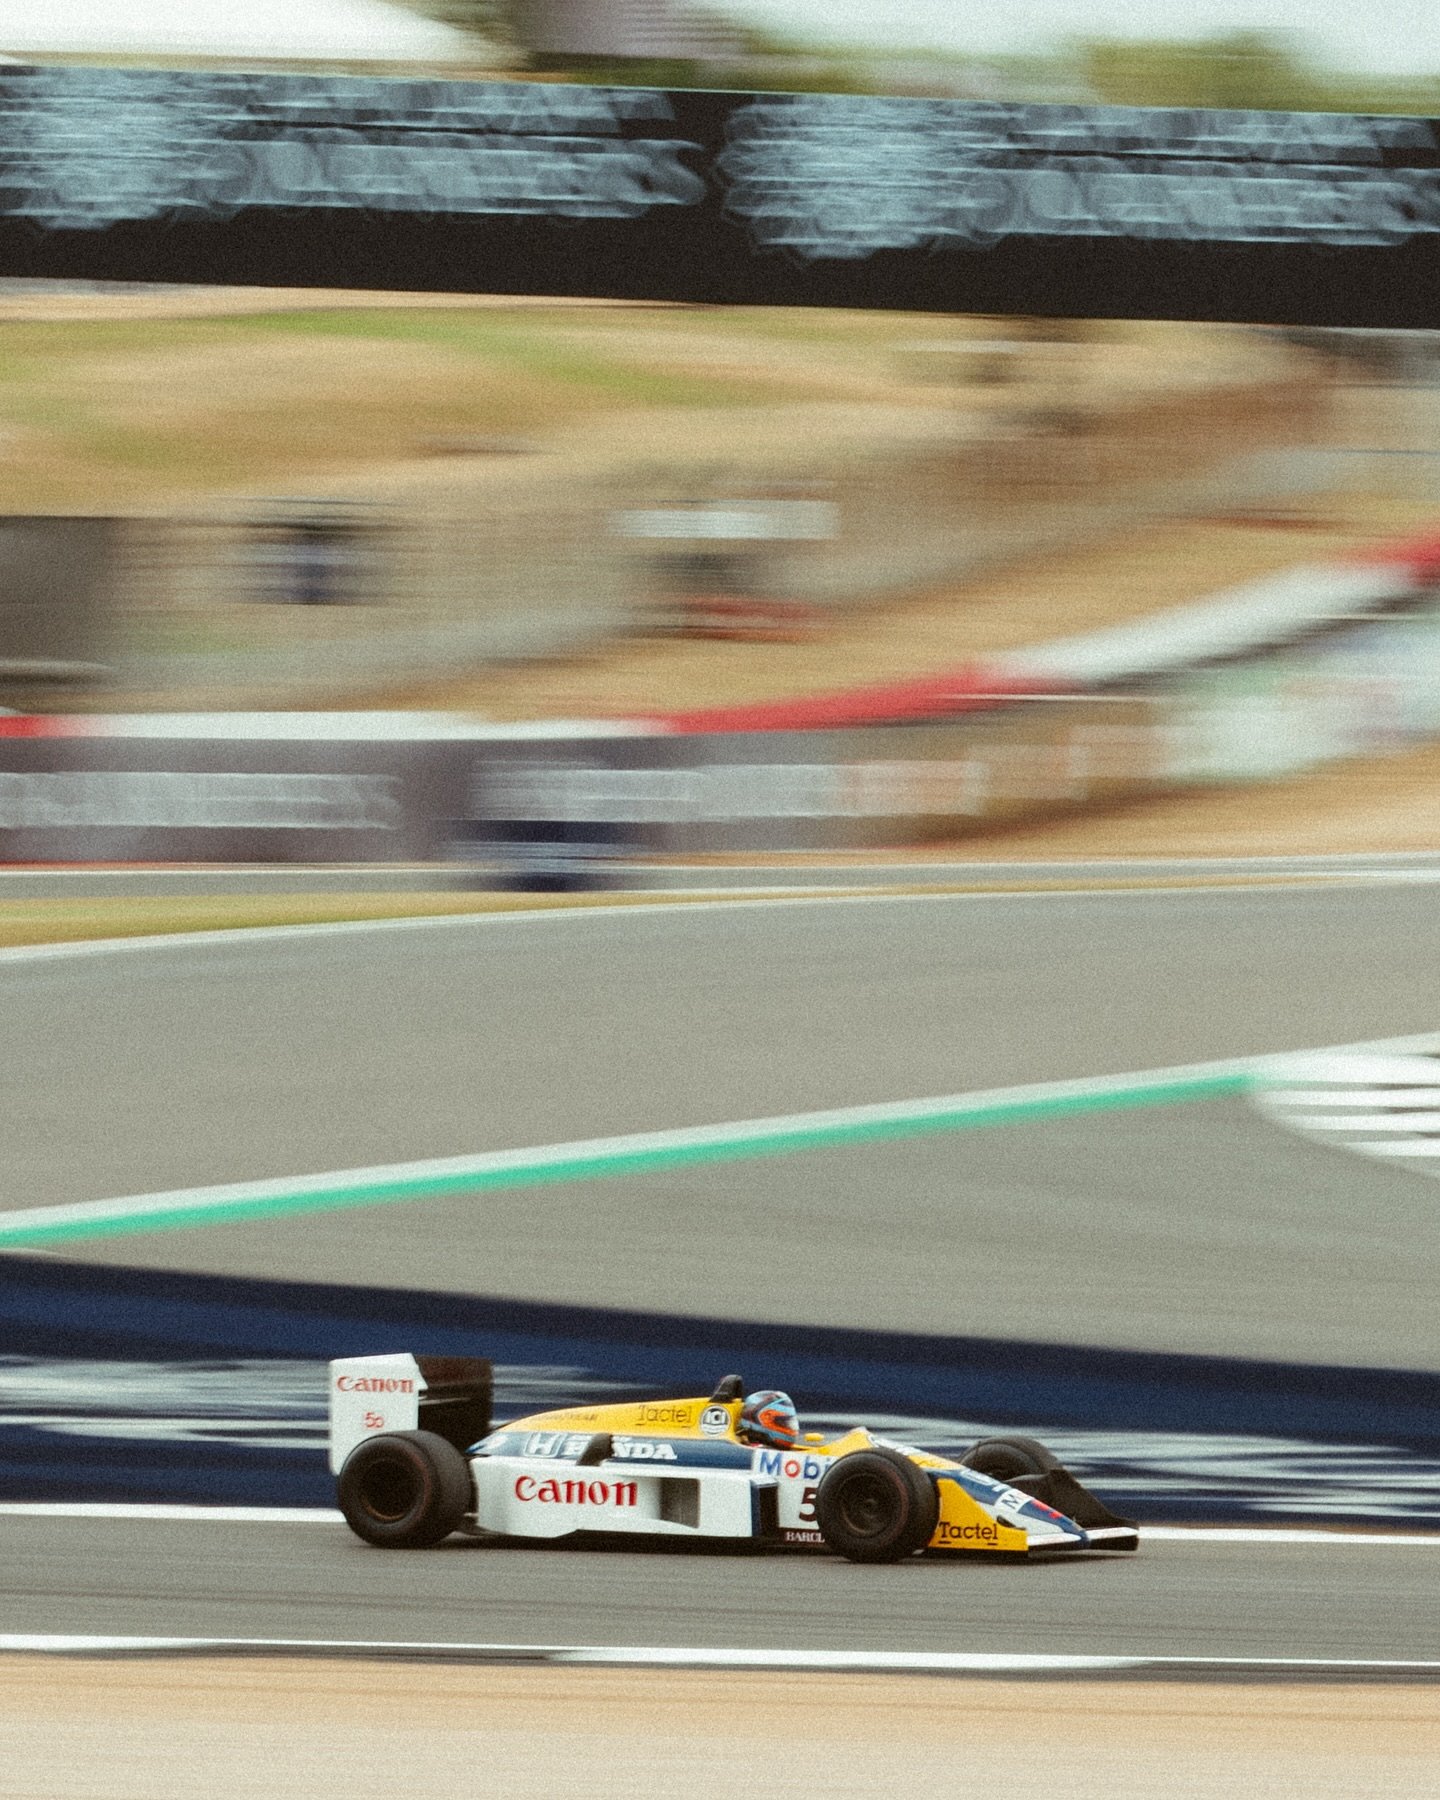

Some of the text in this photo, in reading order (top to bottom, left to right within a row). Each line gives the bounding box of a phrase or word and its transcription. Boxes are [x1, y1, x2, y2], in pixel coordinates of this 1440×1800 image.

[336, 1375, 414, 1393] Canon
[637, 1405, 692, 1423] Tactel
[706, 1411, 726, 1424] ICI
[561, 1441, 677, 1459] HNDA
[759, 1452, 832, 1479] Mobi
[514, 1475, 637, 1506] Canon
[799, 1487, 818, 1522] 5
[785, 1531, 825, 1543] BARCL
[939, 1522, 998, 1540] Tactel
